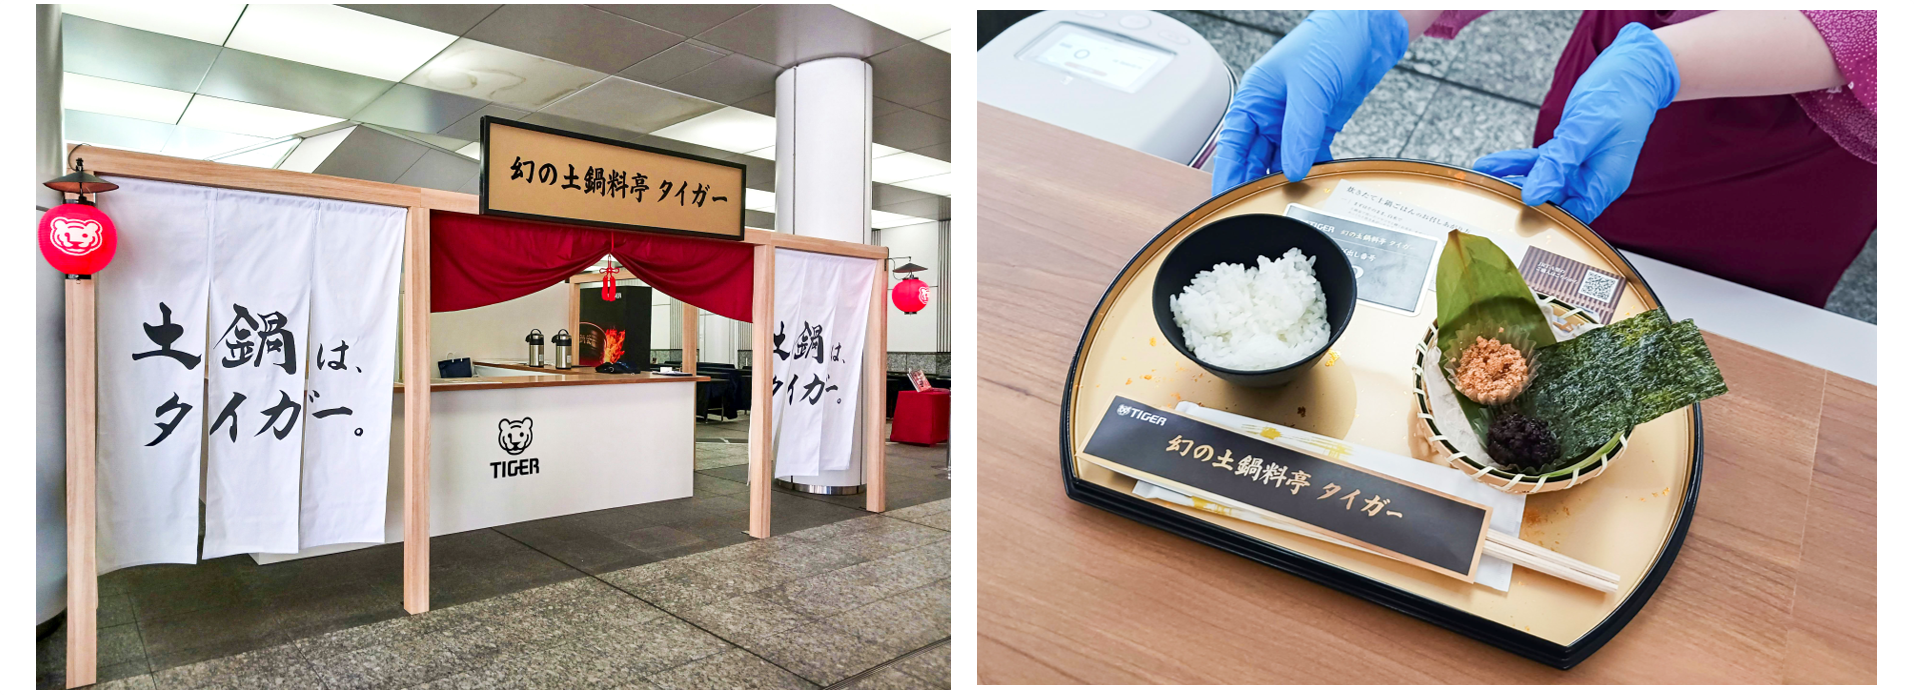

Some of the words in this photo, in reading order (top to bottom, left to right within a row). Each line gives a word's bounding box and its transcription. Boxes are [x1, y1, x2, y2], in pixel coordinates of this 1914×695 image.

[510, 156, 650, 203] 幻の土鍋料亭
[657, 179, 728, 208] タイガー
[131, 301, 362, 375] 土鍋は、
[144, 390, 364, 447] タイガー。
[1129, 408, 1168, 427] TIGER
[490, 457, 540, 479] TIGER
[1165, 434, 1311, 496] 幻の土鍋料亭
[1316, 482, 1404, 520] タイガー
